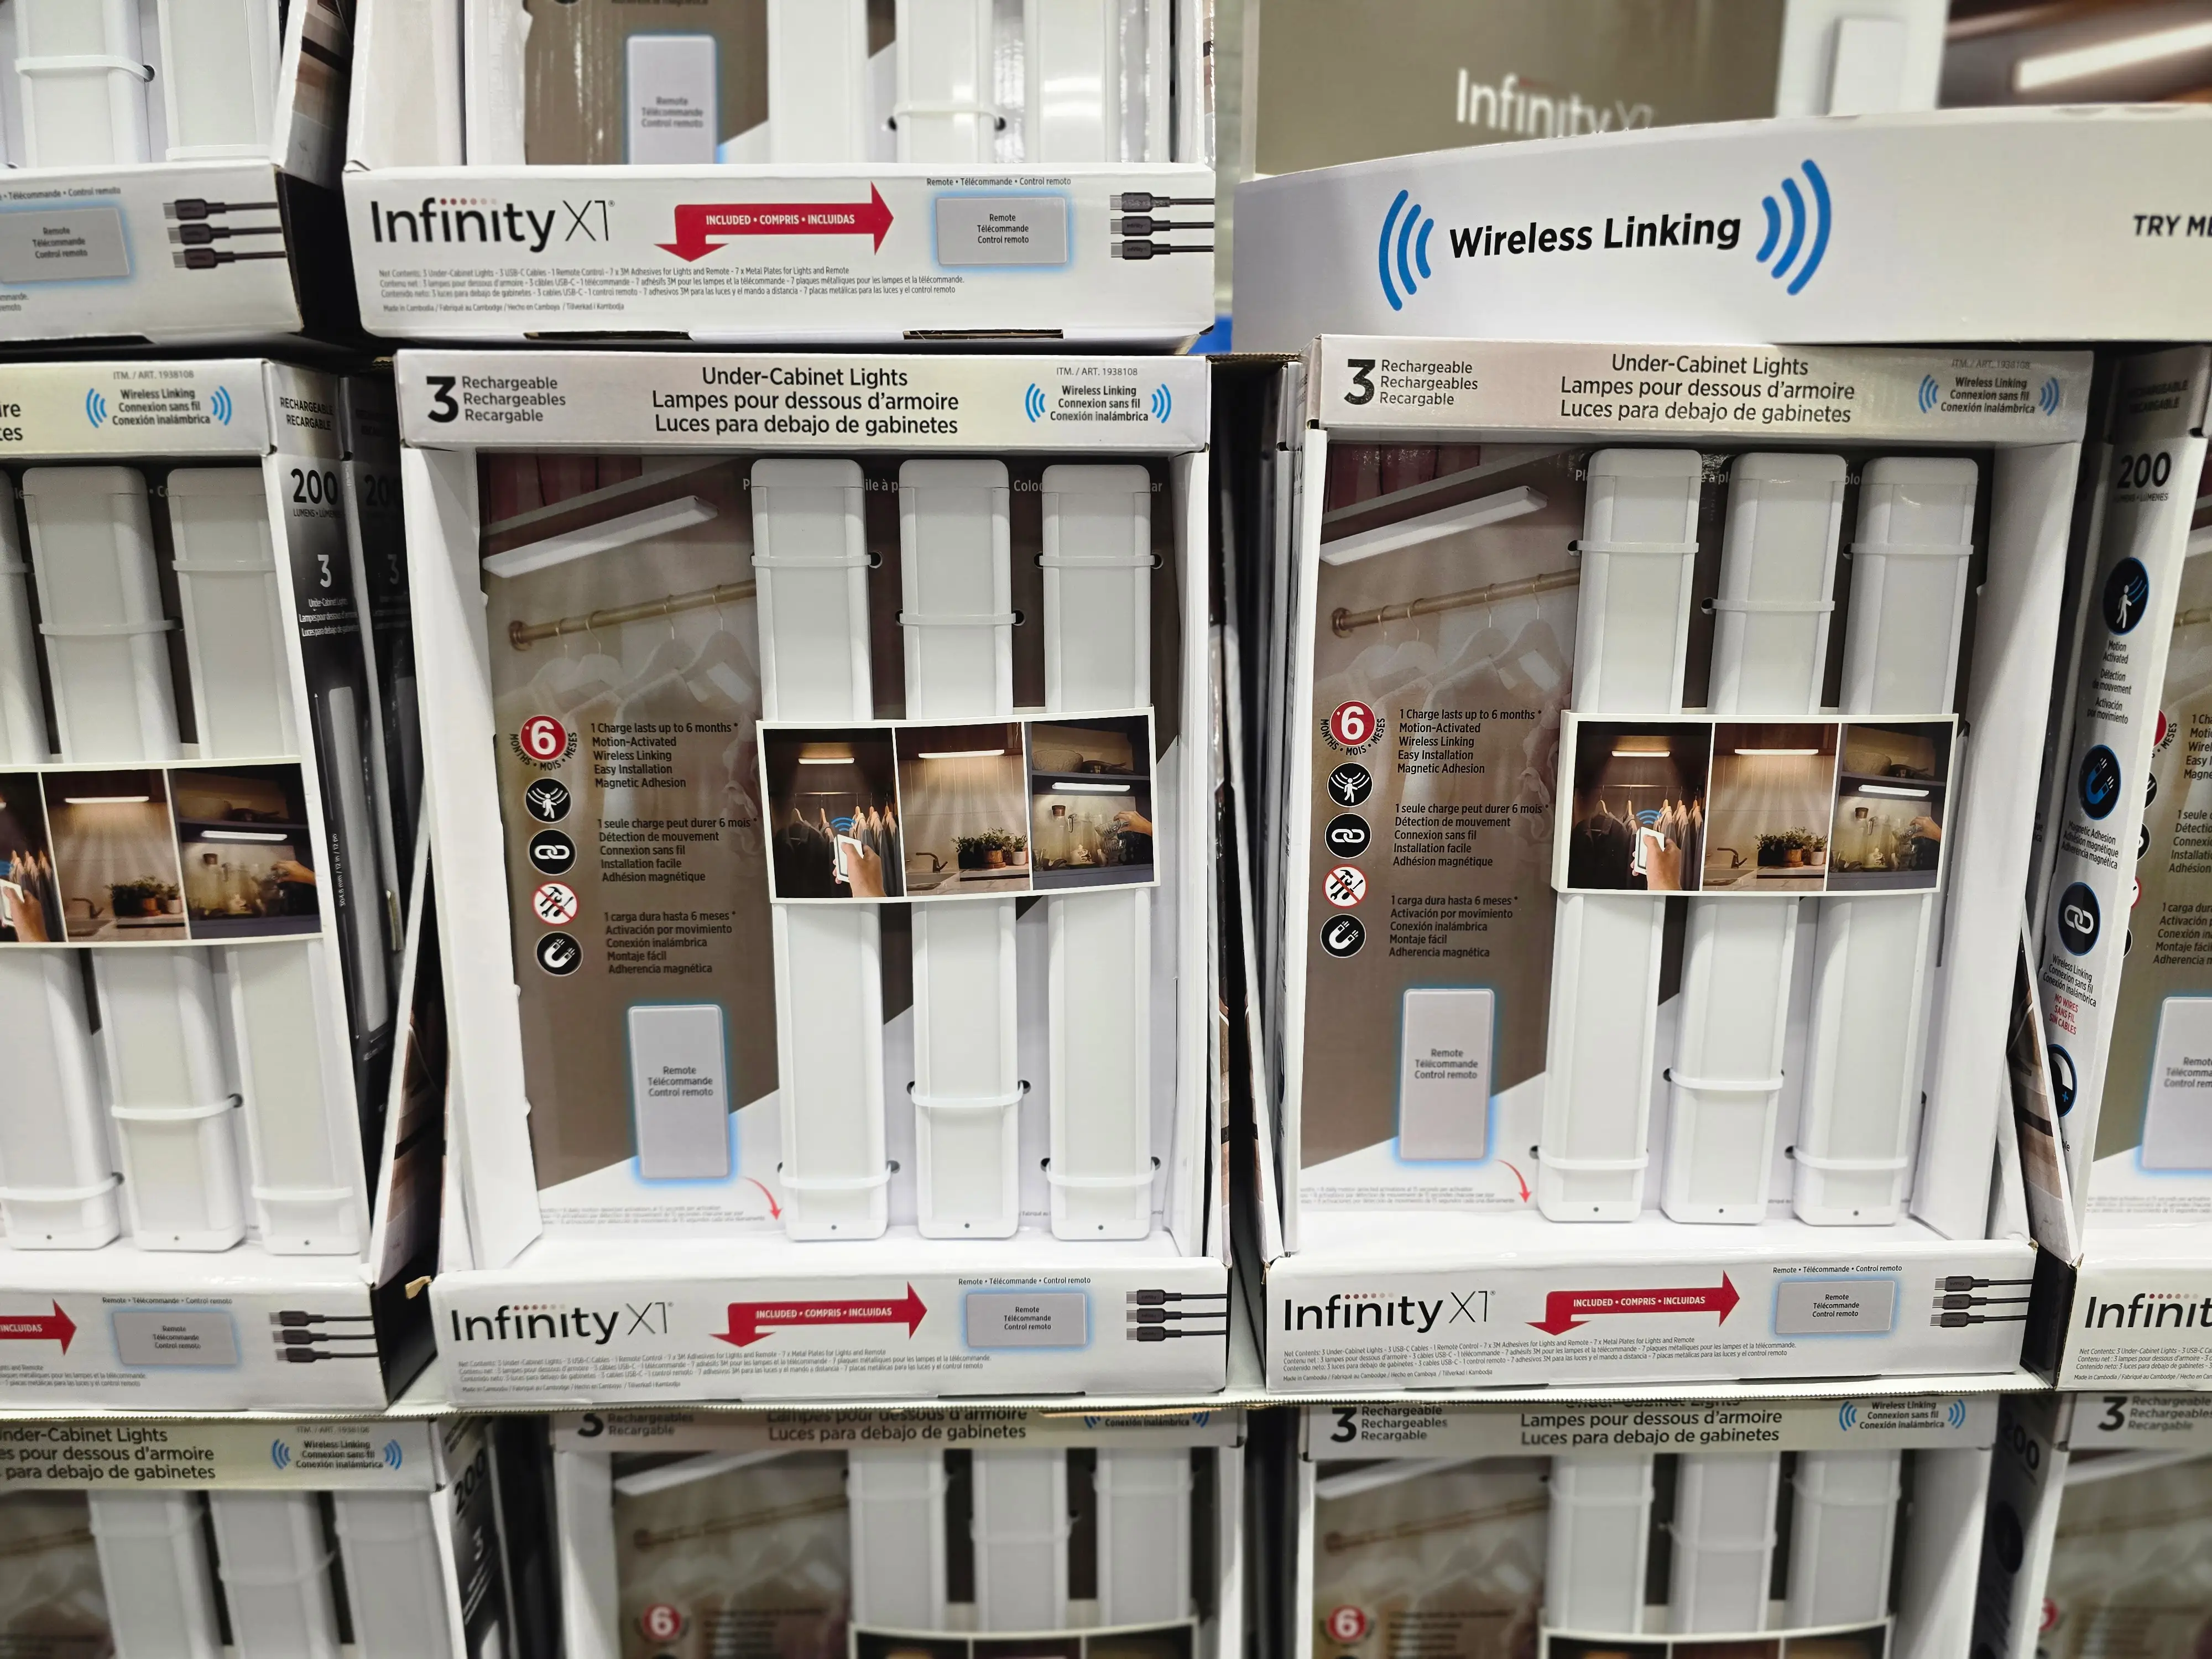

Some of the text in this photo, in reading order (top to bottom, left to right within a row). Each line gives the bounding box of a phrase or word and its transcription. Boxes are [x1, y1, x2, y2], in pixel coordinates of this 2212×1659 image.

[926, 177, 1071, 186] Remote Télécommande Control remoto
[706, 214, 855, 225] INCLUDED COMPRIS INCLUIDAS
[989, 213, 1016, 221] Remote
[371, 197, 556, 253] Infinity
[977, 225, 1029, 233] Télécommande
[2133, 214, 2182, 237] TRY
[978, 235, 1003, 244] Control
[1449, 213, 1741, 258] Wireless Linking
[1056, 367, 1138, 376] ITM. ART. 1938108
[1381, 359, 1473, 375] Rechargeable
[1612, 353, 1808, 378] Under-Cabinet Lights
[462, 376, 557, 392] Rechargeable
[702, 367, 908, 389] Under-Cabinet Lights
[1344, 358, 1375, 406] 3
[1380, 375, 1478, 391] Rechargeables
[120, 388, 195, 400] Wireless Linking
[1061, 385, 1136, 398] Wireless Linking
[1561, 376, 1634, 398] Lampes
[1639, 382, 1683, 398] pour
[1688, 378, 1761, 398] dessous
[426, 375, 458, 423] 3
[463, 392, 566, 408] Rechargeables
[653, 390, 728, 412] Lampes
[734, 395, 779, 412] pour
[785, 391, 862, 410] dessous
[1058, 398, 1140, 409] Connexion sans fil
[1380, 392, 1454, 407] Recargable
[118, 401, 201, 413] Connexion sans fil
[279, 397, 335, 416] RECHARGEABLE
[1561, 399, 1851, 425] Luces para debajo de gabinetes
[112, 414, 211, 425] Conexión inalámbrica
[286, 414, 331, 431] RECARGABLE
[465, 408, 544, 424] Recargable
[1050, 411, 1149, 421] Conexión inalámbrica
[655, 414, 958, 436] Luces para debajo de gabinetes
[2117, 451, 2172, 489] 200
[290, 468, 338, 505] 200
[317, 554, 332, 588] 3
[2107, 639, 2127, 652] Motion
[2102, 650, 2128, 665] Activated
[1400, 708, 1535, 721] 1 Charge lasts up to 6 months
[1340, 705, 1365, 740] 6
[1399, 722, 1481, 733] Motion-Activated
[1319, 717, 1385, 756] MONTHS MOIS MESES
[1399, 735, 1474, 748] Wireless Linking
[1398, 750, 1473, 761] Easy Installation
[1397, 763, 1485, 775] Magnetic Adhesion
[1395, 803, 1542, 816] 1 seule charge peut durer 6 mois
[1395, 816, 1511, 827] Détection de mouvement
[1394, 830, 1443, 840] Connexion
[1468, 830, 1477, 840] fil
[1394, 843, 1472, 853] Installation facile
[1392, 855, 1493, 868] Adhésion magnétique
[1391, 895, 1395, 905] 1
[1397, 898, 1423, 907] carga
[1425, 895, 1446, 905] dura
[1448, 895, 1473, 905] hasta
[1474, 896, 1481, 905] 6
[1390, 908, 1513, 920] Activación por movimiento
[1390, 921, 1488, 931] Conexión inalámbrica
[1390, 933, 1447, 946] Montaje fácil
[1389, 947, 1490, 958] Adherencia magnética
[2054, 993, 2079, 1013] NO WIRES
[2054, 1005, 2068, 1019] SANS
[2049, 1013, 2077, 1035] SIN CABLES
[1573, 1296, 1705, 1307] INCLUDED COMPRIS INCLUIDAS
[756, 1307, 892, 1319] INCLUDED COMPRIS INCLUIDAS
[1285, 1294, 1443, 1334] Infinity
[451, 1305, 619, 1345] Infinity
[1296, 1348, 1321, 1357] Contents:
[1326, 1347, 1365, 1355] Under-Cabinet
[1366, 1347, 1383, 1355] Lights
[1521, 1413, 1585, 1429] Lampes
[1590, 1415, 1629, 1428] pour
[1633, 1411, 1699, 1426] dessous
[1522, 1427, 1780, 1446] Luces para debajo de gabinetes
